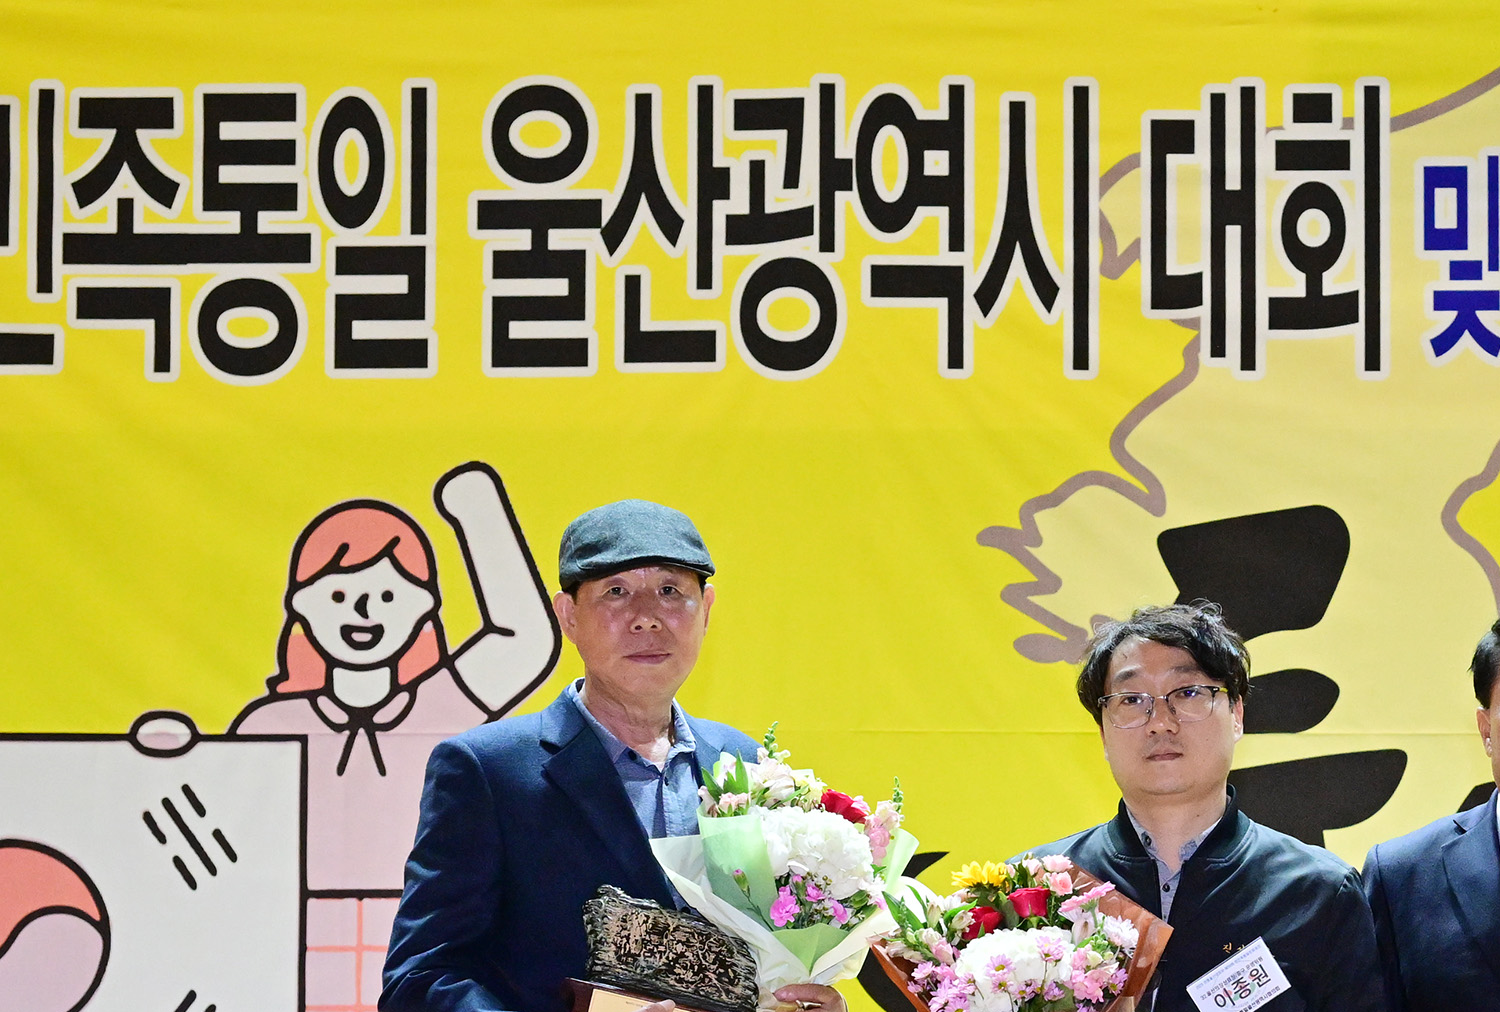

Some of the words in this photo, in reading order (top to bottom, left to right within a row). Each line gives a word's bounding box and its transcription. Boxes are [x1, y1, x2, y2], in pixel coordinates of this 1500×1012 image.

[478, 83, 1091, 372] 울산광역시
[1150, 85, 1387, 373] 대회
[1213, 963, 1272, 1009] 이종원
